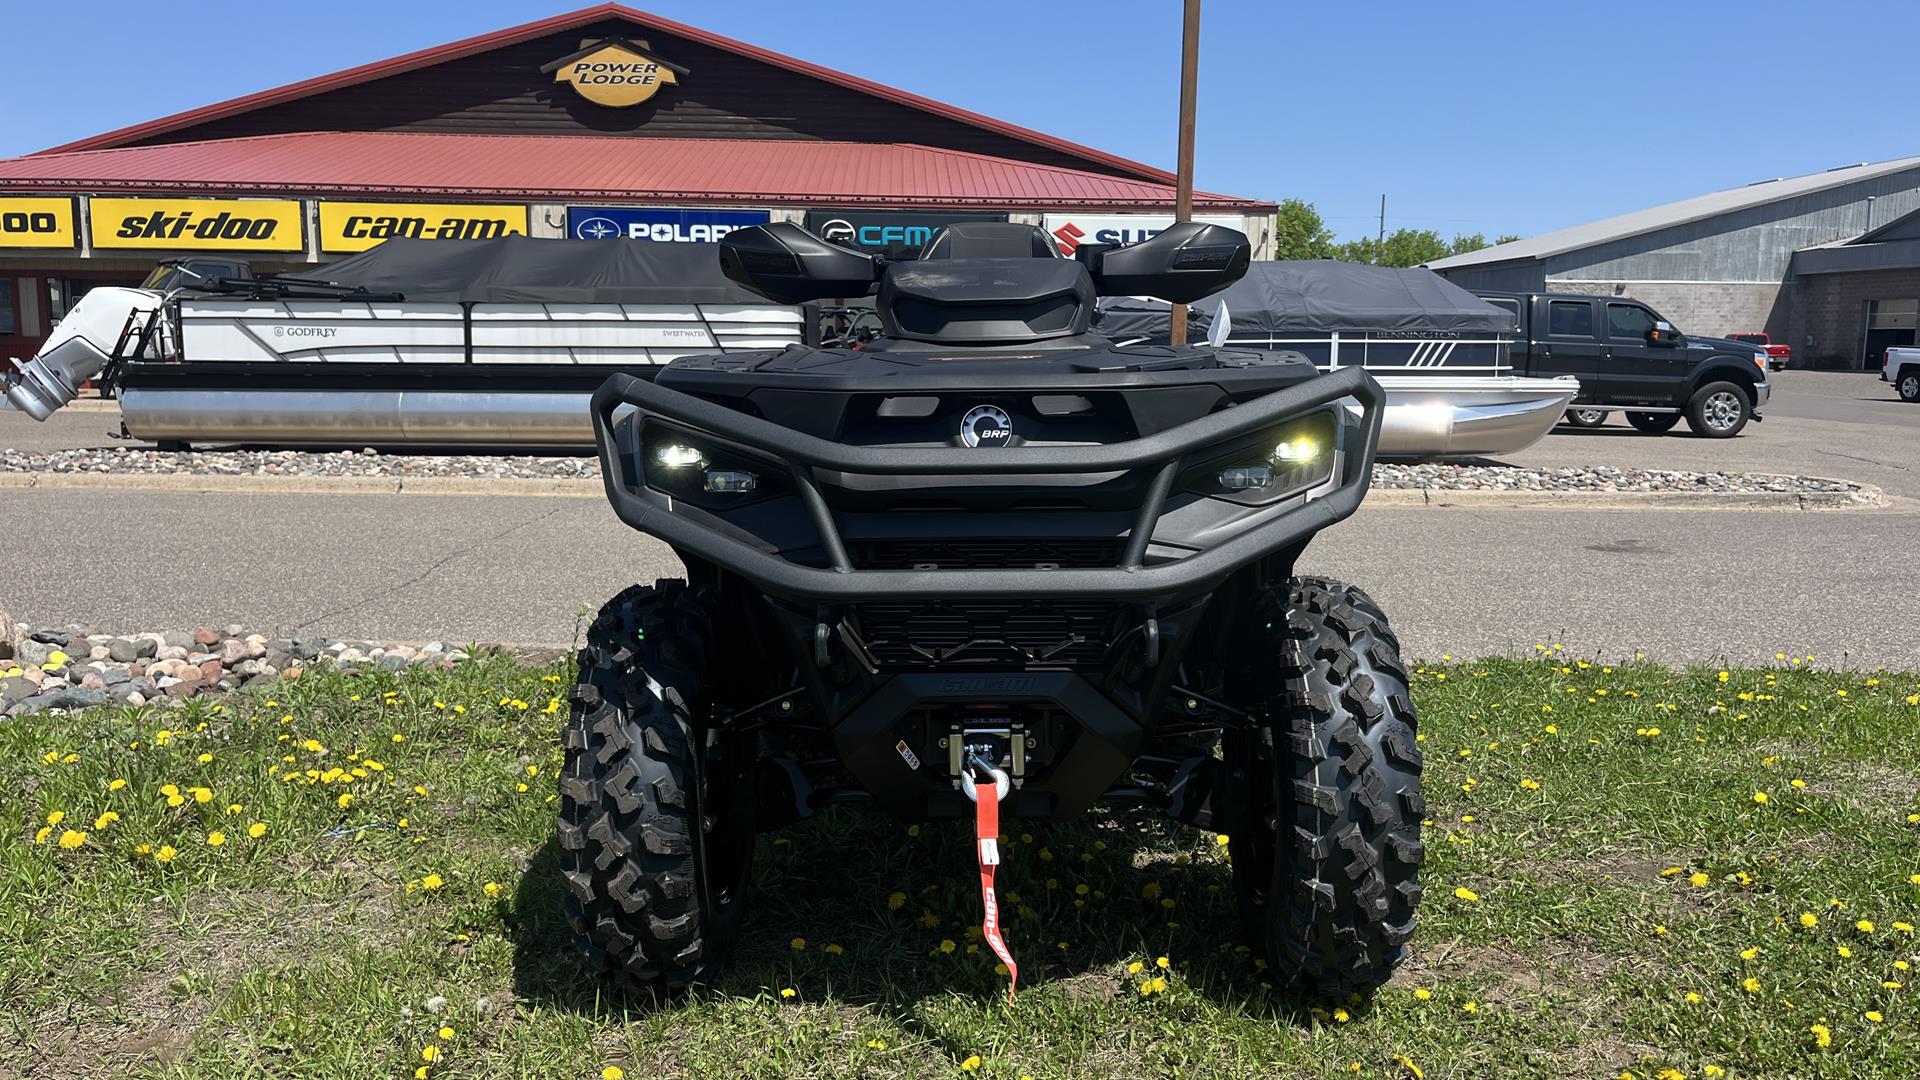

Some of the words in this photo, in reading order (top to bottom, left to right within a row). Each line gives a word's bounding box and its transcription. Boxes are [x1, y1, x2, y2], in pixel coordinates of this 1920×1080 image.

[574, 63, 659, 74] POWER
[578, 73, 656, 85] LODGE
[116, 211, 278, 240] ski-doo
[342, 216, 507, 240] can-am
[628, 223, 752, 243] POLAR
[859, 226, 941, 246] CFM
[287, 327, 337, 338] GODFREY
[1376, 331, 1460, 339] BENNINGTON
[981, 429, 1010, 439] BRP
